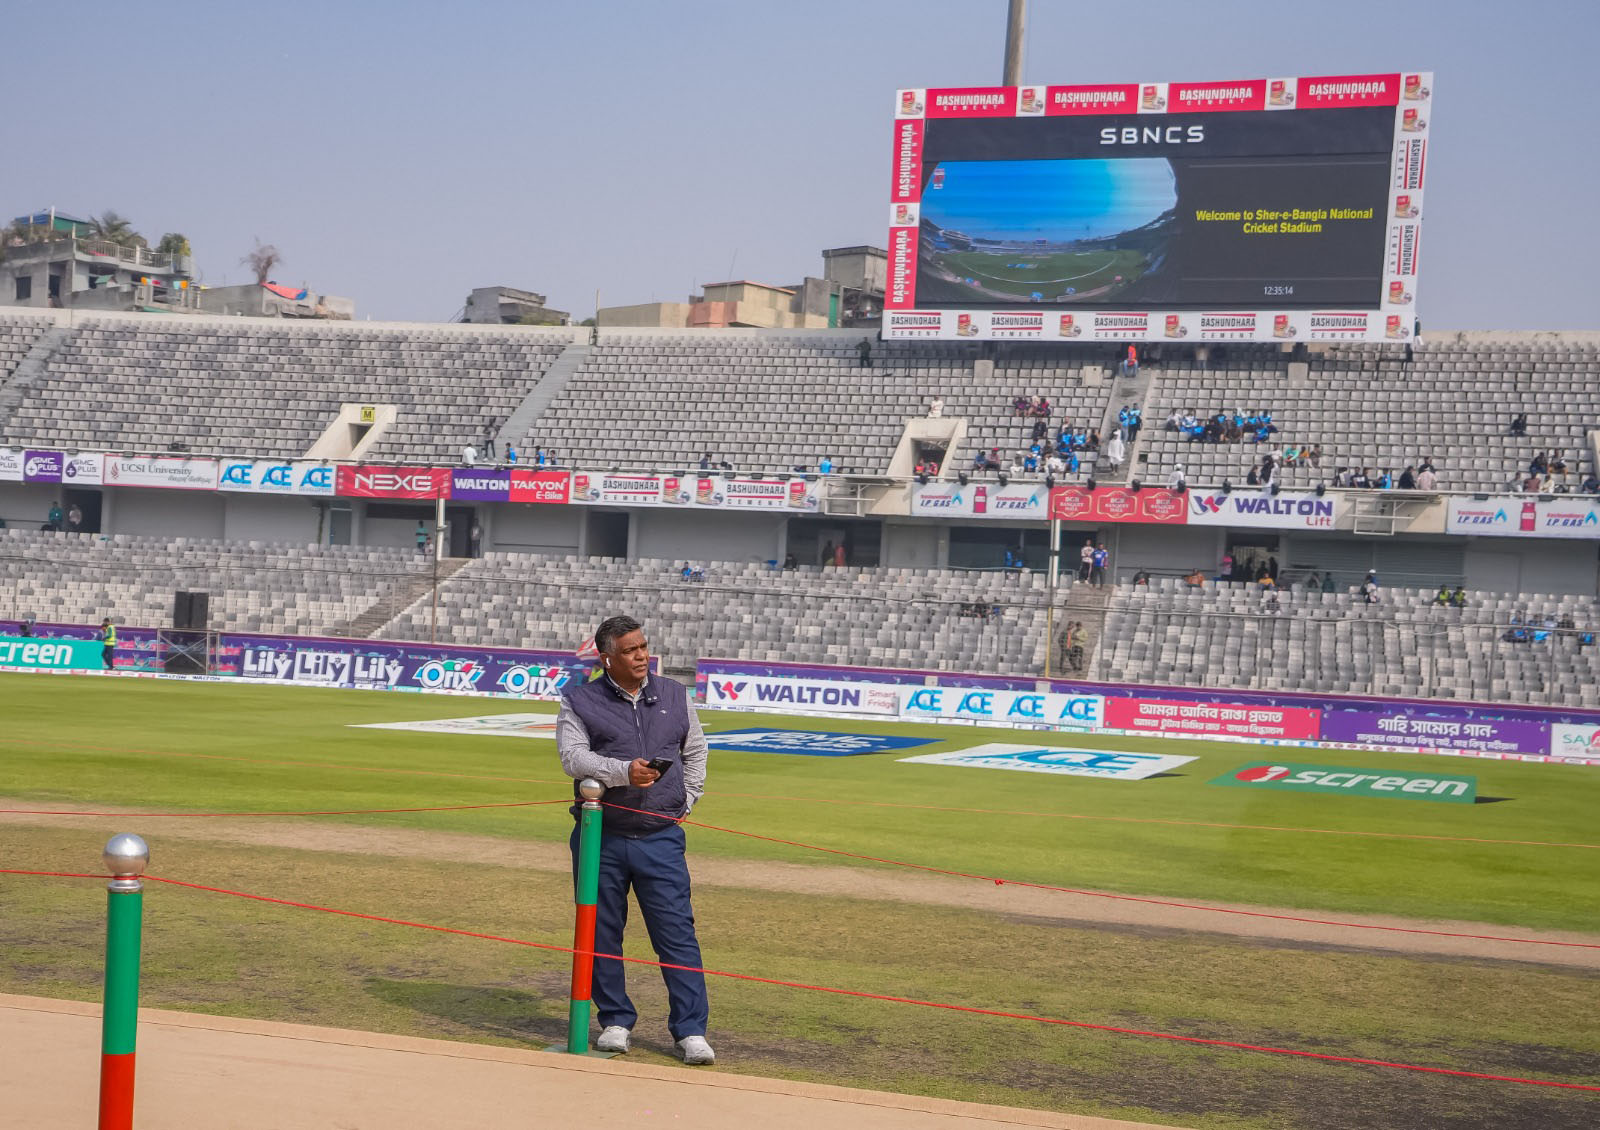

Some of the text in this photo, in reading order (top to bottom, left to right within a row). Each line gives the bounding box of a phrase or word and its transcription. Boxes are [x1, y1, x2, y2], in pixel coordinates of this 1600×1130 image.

[1180, 88, 1252, 101] BASHUNDHARA
[1309, 82, 1386, 96] BASHUNDHARA
[936, 94, 1005, 106] BASHUNDHARA
[1055, 91, 1125, 104] BASHUNDHARA
[1100, 126, 1205, 145] SBNCS
[899, 124, 913, 197] BASHUNDHARA
[1408, 139, 1421, 190] BASHUNDHARA
[1196, 207, 1373, 221] Welcome to Sher-e-Bangla National
[1243, 222, 1322, 234] Cricket Stadium
[1402, 225, 1414, 276] BASHUNDHARA
[893, 230, 908, 303] BASHUNDHARA
[1263, 286, 1293, 296] 12:35:14
[891, 316, 941, 326] BASHUNDHARA
[991, 316, 1043, 326] BASHUNDHARA
[1095, 317, 1148, 327] BASHUNDHARA
[1201, 317, 1256, 327] BASHUNDHARA
[1310, 317, 1367, 327] BASHUNDHARA
[37, 463, 59, 471] PLUS
[121, 463, 192, 477] UCSI University
[220, 464, 252, 484] ACE
[260, 466, 293, 486] ACE
[300, 468, 333, 488] ACE
[355, 473, 432, 491] NEXG
[454, 478, 509, 491] WALTON
[511, 480, 565, 490] TAKYON
[603, 480, 659, 491] BASHUNDHARA
[727, 484, 785, 495] BASHUNDHARA
[536, 491, 563, 500] E-Bike
[996, 501, 1005, 509] LP
[1234, 498, 1333, 516] WALTON
[1306, 516, 1331, 526] Lift
[1457, 515, 1494, 524] LP GAS
[1546, 518, 1584, 527] LP GAS
[0, 641, 73, 665] creen
[243, 650, 293, 679] Lily
[301, 653, 347, 682] Lily
[355, 656, 404, 686] Lily
[420, 659, 478, 691] Orix
[505, 665, 563, 696] Orix
[756, 683, 860, 706] WALTON
[868, 690, 896, 698] Smart
[906, 689, 943, 711] ACE
[867, 700, 896, 709] Fridge
[956, 692, 994, 714] ACE
[1007, 695, 1045, 717] ACE
[1059, 698, 1098, 720] ACE
[1139, 704, 1178, 716] আমরা
[1180, 704, 1218, 719] আনিব
[1378, 715, 1409, 734] গাহি
[1410, 720, 1461, 736] সাম্যের
[1563, 734, 1591, 746] SAJ
